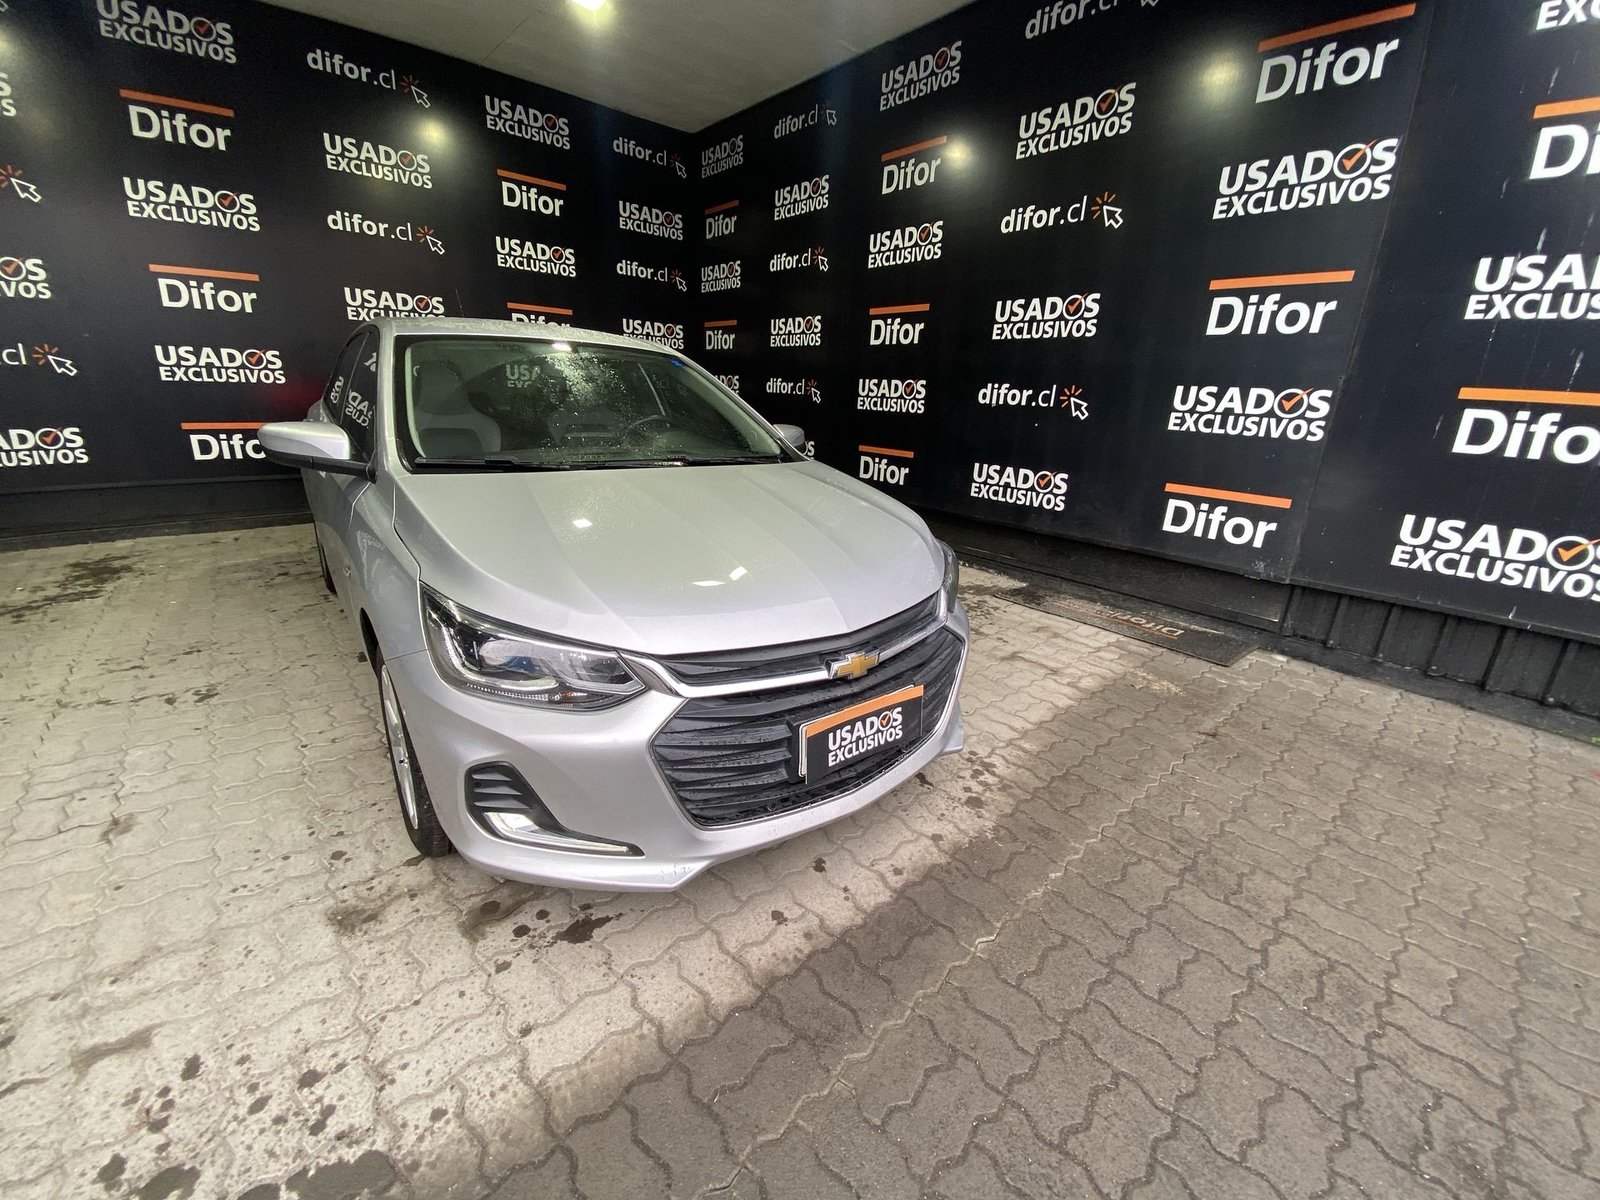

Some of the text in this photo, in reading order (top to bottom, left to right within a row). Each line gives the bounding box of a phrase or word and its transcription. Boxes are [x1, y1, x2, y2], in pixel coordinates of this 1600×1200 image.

[97, 0, 233, 45] USADOS
[1025, 0, 1117, 39] difor.
[99, 19, 237, 64] EXCLUSIVOS
[306, 49, 396, 90] difor.cl
[881, 40, 962, 93] USADOS
[1255, 38, 1400, 104] Difor
[880, 66, 960, 112] EXCLUSIVOS
[485, 95, 569, 135] USADOS
[774, 104, 819, 140] difor.cl
[1018, 82, 1137, 139] USADOS
[128, 104, 231, 150] Difor
[486, 115, 570, 149] EXCLUSIVOS
[1016, 112, 1133, 160] EXCLUSIVOS
[323, 132, 430, 173] USADOS
[613, 137, 667, 166] difor.cl
[701, 135, 744, 166] USADOS
[701, 152, 744, 179] EXCLUSIVOS
[325, 154, 433, 189] EXCLUSIVOS
[882, 158, 941, 195] Difor
[1218, 137, 1399, 196] USADOS
[123, 176, 257, 215] USADOS
[501, 181, 563, 216] Difor
[774, 174, 830, 207] USADOS
[1212, 173, 1392, 220] EXCLUSIVOS
[127, 201, 260, 231] EXCLUSIVOS
[619, 200, 683, 229] USADOS
[774, 194, 829, 221] EXCLUSIVOS
[1000, 195, 1088, 234] difor.cl
[327, 211, 412, 241] difor.cl
[619, 218, 683, 240] EXCLUSIVOS
[705, 213, 737, 239] Difor
[869, 221, 944, 253] USADOS
[495, 236, 575, 265] USADOS
[497, 253, 576, 277] EXCLUSIVOS
[769, 247, 812, 272] difor.cl
[868, 243, 942, 269] EXCLUSIVOS
[616, 260, 668, 282] difor.cl
[701, 260, 741, 281] USADOS
[701, 276, 741, 293] EXCLUSIVOS
[1474, 253, 1600, 292] USA
[157, 278, 257, 313] Difor
[344, 287, 444, 314] USADOS
[995, 293, 1101, 323] USADOS
[622, 318, 684, 338] USADOS
[770, 315, 822, 335] USADOS
[992, 319, 1098, 340] EXCLUSIVOS
[1206, 293, 1338, 336] Difor
[706, 330, 736, 350] Difor
[770, 333, 821, 347] EXCLUSIVOS
[870, 319, 924, 346] Difor
[155, 345, 282, 370] USADOS
[160, 367, 286, 384] EXCLUSIVOS
[766, 378, 805, 395] difor.cl
[858, 379, 926, 399] USADOS
[857, 397, 925, 414] EXCLUSIVOS
[978, 384, 1057, 408] difor.cl
[1173, 385, 1333, 419] USADOS
[1167, 412, 1326, 442] EXCLUSIVOS
[1451, 408, 1600, 464] Difo
[0, 449, 88, 467] USIVOS
[190, 434, 266, 460] Difo
[859, 456, 909, 486] Difor
[972, 462, 1068, 494] USADOS
[970, 482, 1066, 511] EXCLUSIVOS
[1161, 499, 1277, 549] Difor
[828, 706, 902, 750] USADOS
[828, 725, 902, 767] EXCLUSIVOS
